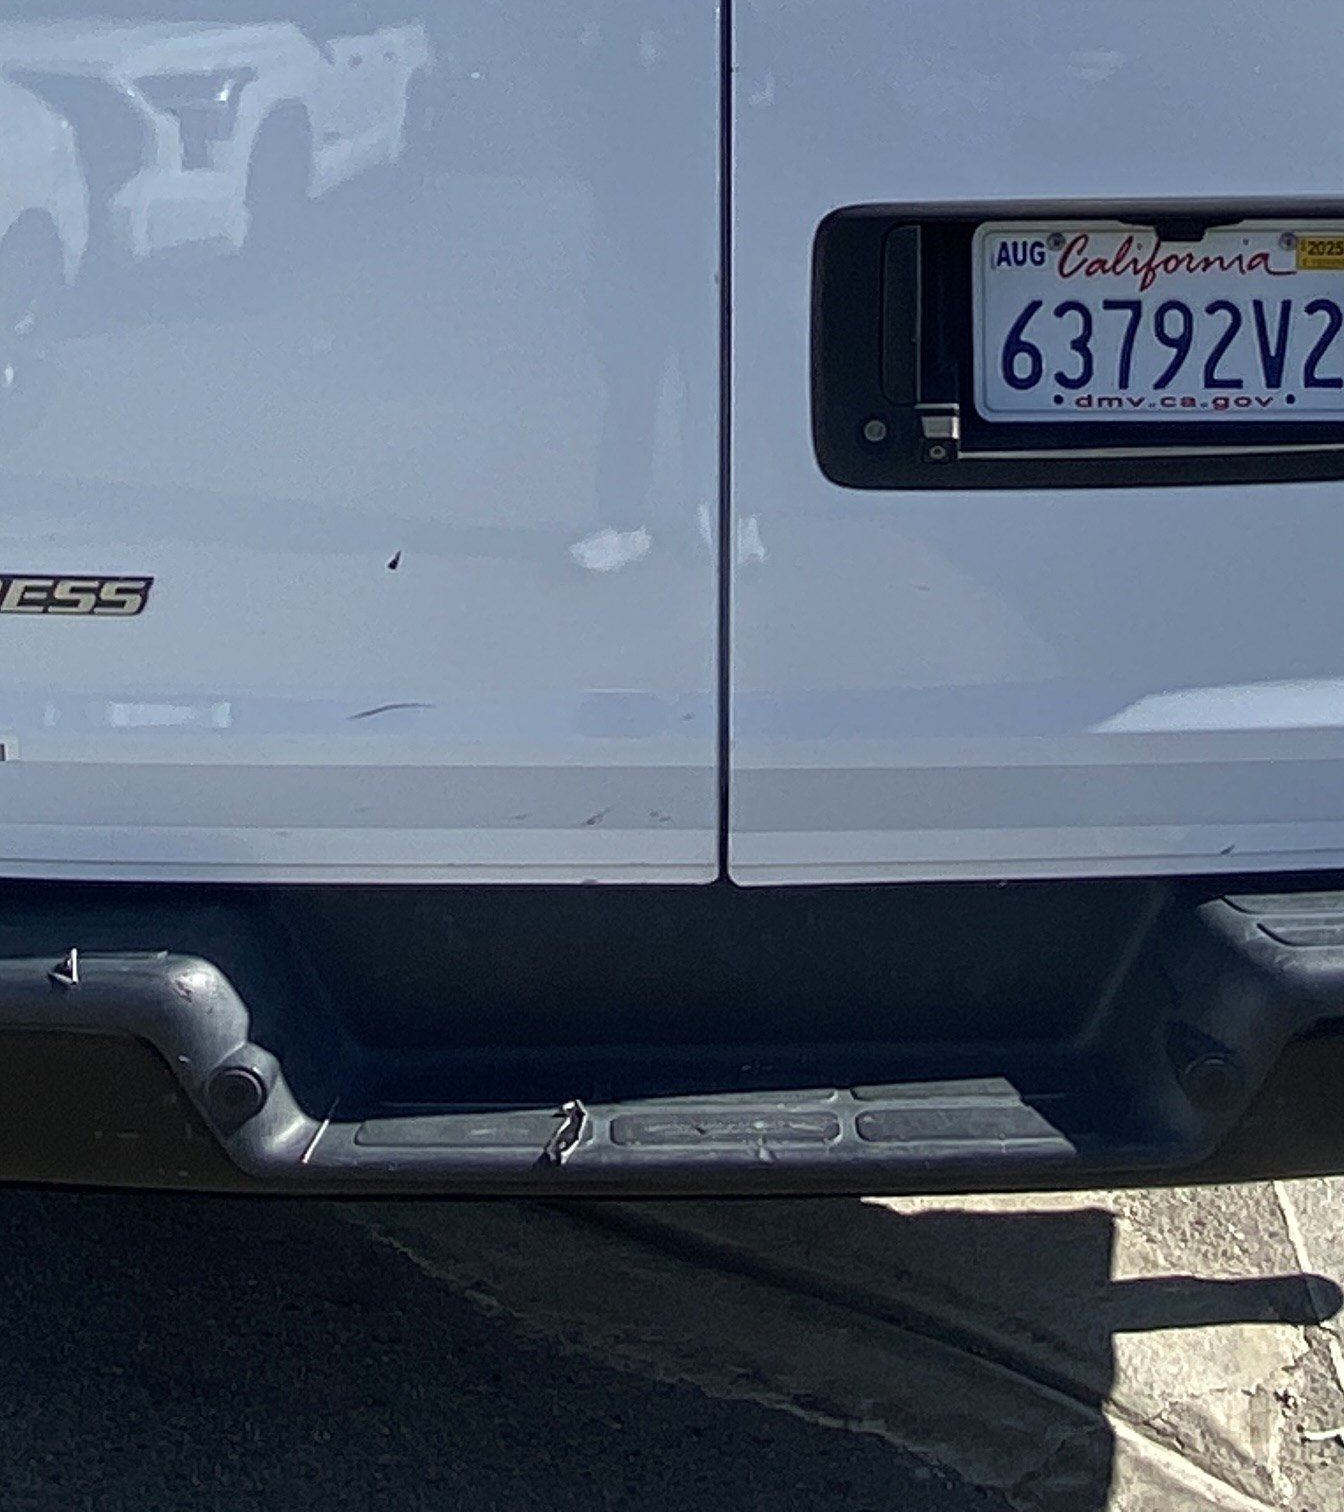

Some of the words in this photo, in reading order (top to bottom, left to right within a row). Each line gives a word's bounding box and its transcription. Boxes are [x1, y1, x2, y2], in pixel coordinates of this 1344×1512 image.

[996, 241, 1046, 267] AUG
[1307, 240, 1344, 257] 2025
[1058, 233, 1297, 291] California
[1002, 299, 1344, 390] 63792V2
[1075, 394, 1274, 410] dmv.ca.gov
